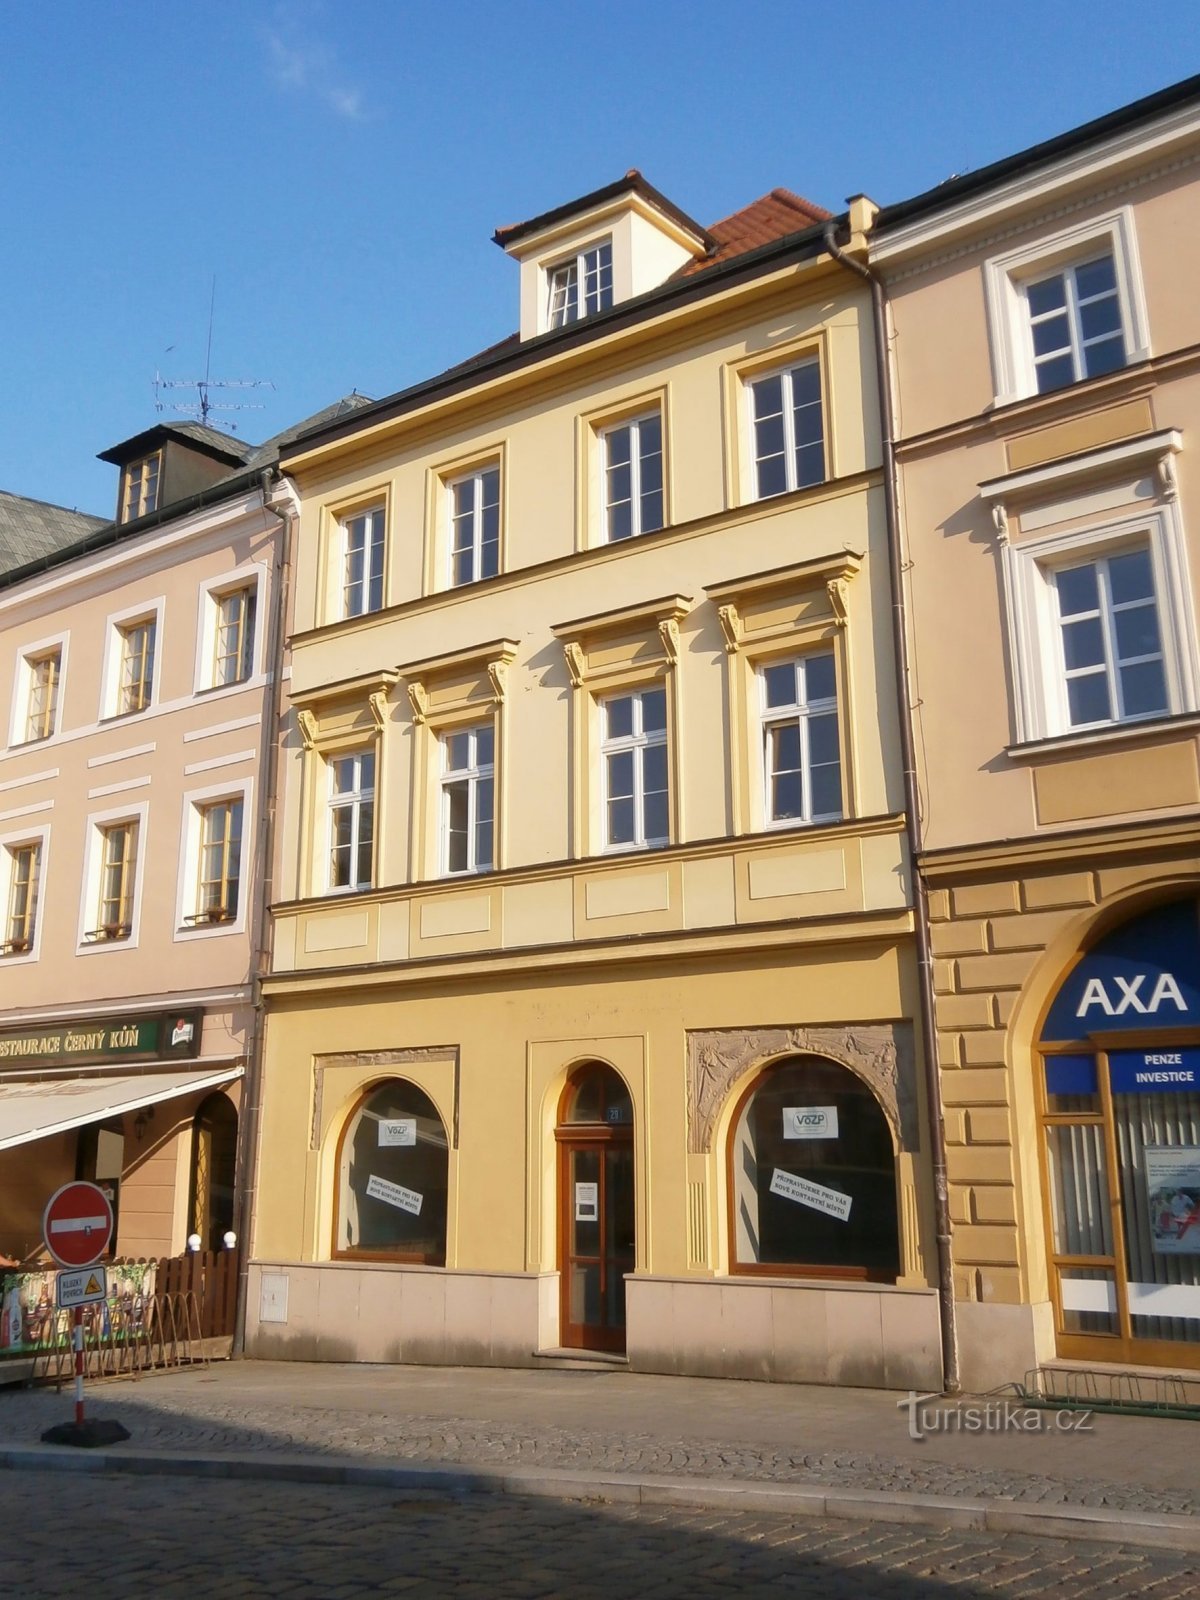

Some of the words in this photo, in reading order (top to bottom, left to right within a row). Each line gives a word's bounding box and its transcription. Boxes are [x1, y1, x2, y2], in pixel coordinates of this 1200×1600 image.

[1076, 973, 1188, 1017] AXA
[64, 1030, 105, 1052] ČERNÝ
[109, 1025, 139, 1048] KŮŇ
[1144, 1054, 1182, 1065] PENZE
[1136, 1071, 1194, 1083] INVESTICE
[777, 1174, 820, 1195] PŘIPRAVUJEME
[821, 1191, 834, 1201] PRO
[835, 1196, 847, 1206] VÁS
[791, 1189, 825, 1207] KONTAKTNÍ
[826, 1202, 845, 1215] MÍSTO
